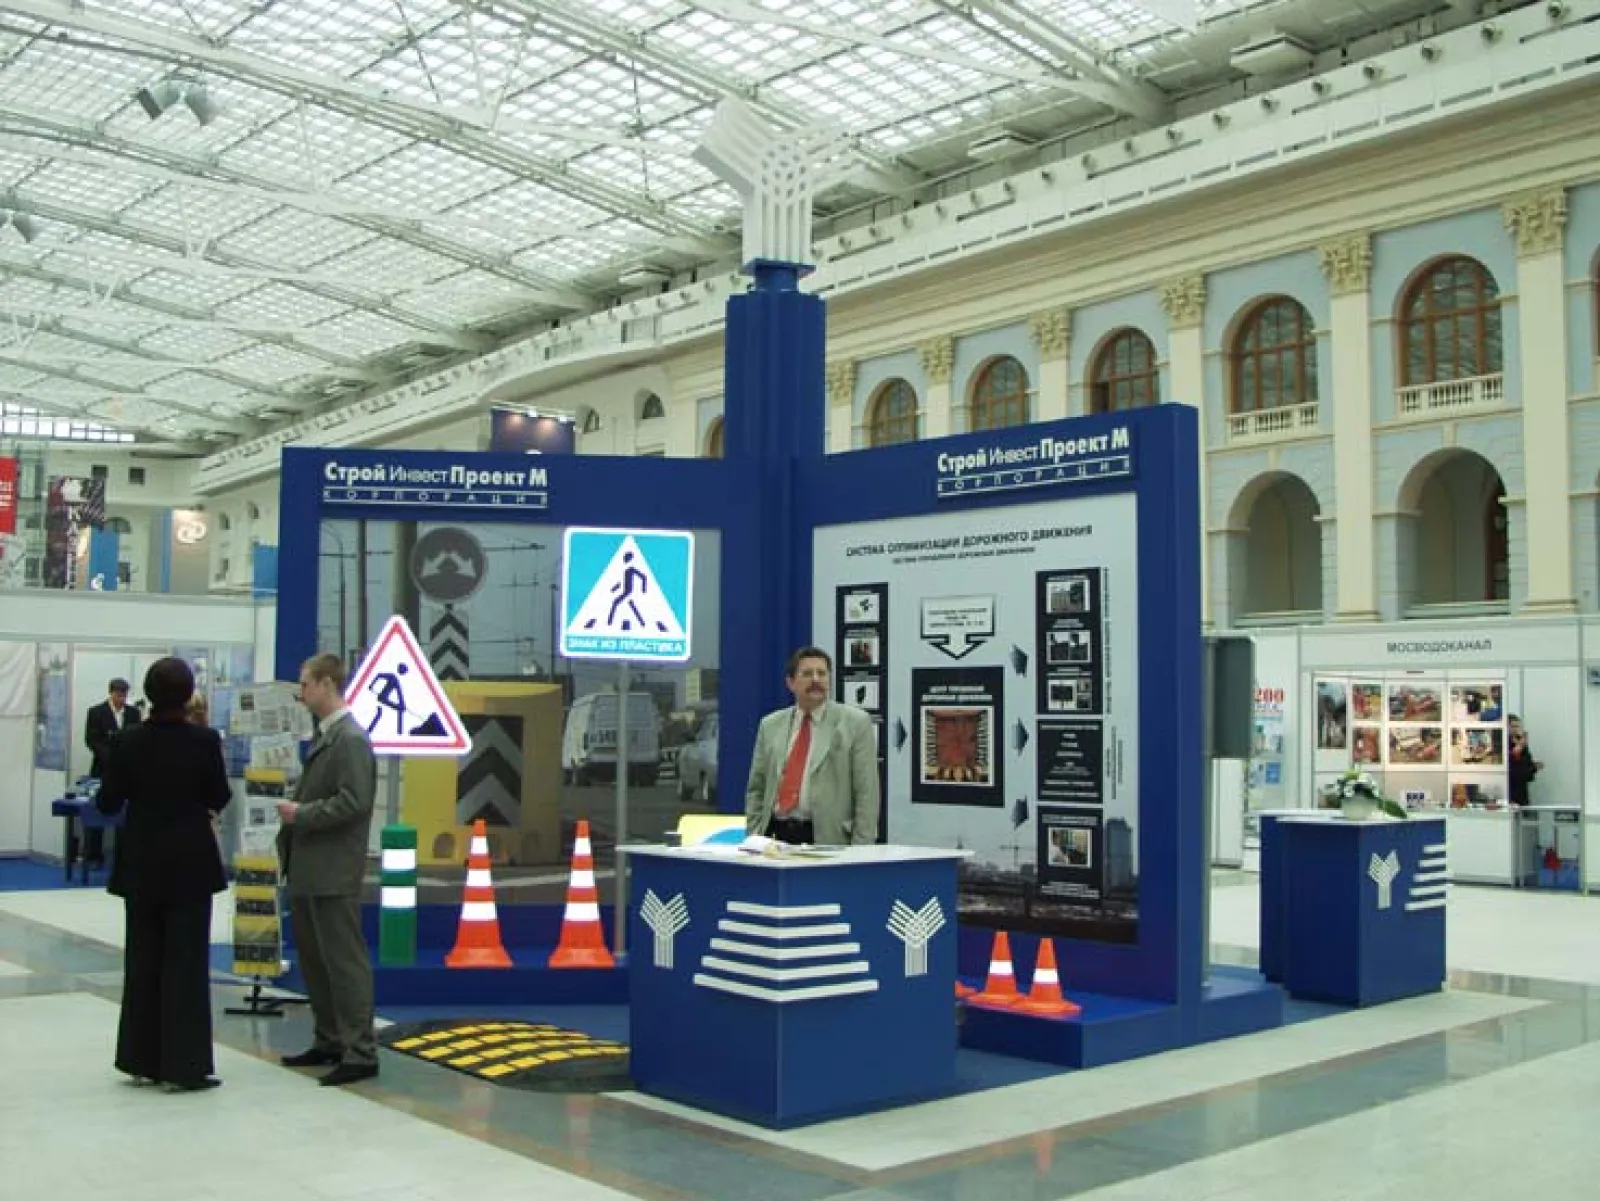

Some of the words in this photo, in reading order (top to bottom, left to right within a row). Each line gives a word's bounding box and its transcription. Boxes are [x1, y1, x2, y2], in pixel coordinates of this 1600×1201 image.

[938, 449, 987, 476] Строй
[1041, 436, 1107, 464] Проект
[1112, 427, 1129, 449] М
[325, 462, 385, 485] Строй
[451, 466, 525, 489] Проект
[530, 468, 547, 487] М
